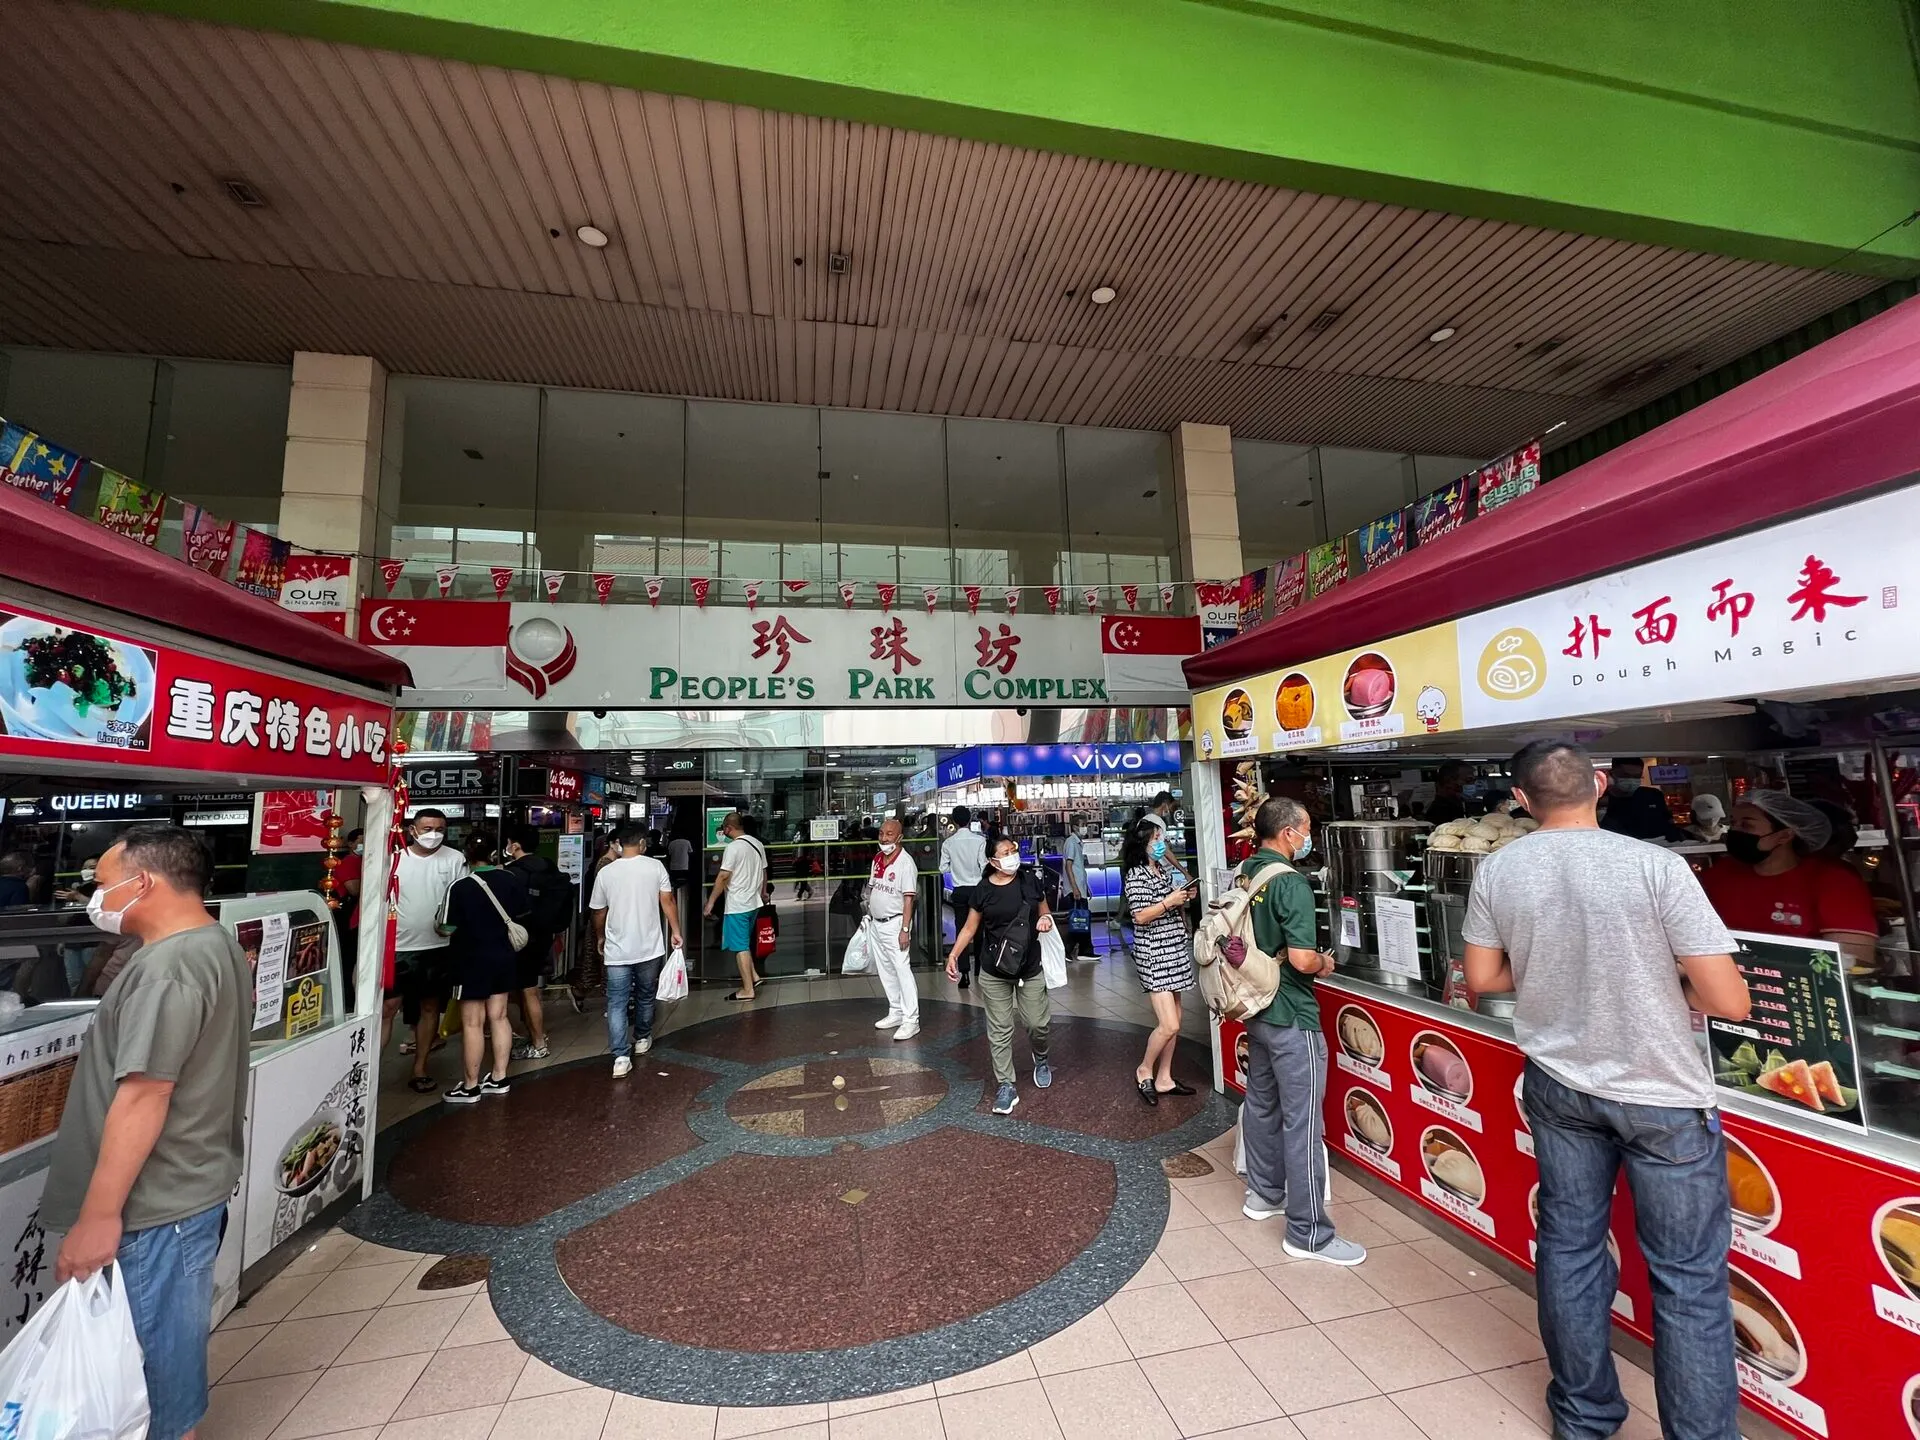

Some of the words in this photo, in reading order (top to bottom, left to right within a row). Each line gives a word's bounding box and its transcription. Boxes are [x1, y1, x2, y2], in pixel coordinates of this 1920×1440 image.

[53, 479, 72, 496] We
[100, 506, 141, 526] Together
[142, 513, 159, 526] We
[217, 530, 232, 544] We
[1314, 567, 1347, 596] Celebrate
[290, 589, 338, 601] OUR
[1207, 611, 1237, 620] OUR
[1561, 554, 1868, 660] 扑面而来
[751, 615, 1022, 675] 珍珠坊
[1572, 656, 1677, 687] Dough
[1714, 627, 1857, 664] Magic
[650, 667, 815, 700] PEOPLE'S
[848, 669, 936, 700] PARK
[964, 669, 1108, 700] COMPLEX
[166, 678, 387, 764] 重庆特色小吃
[97, 731, 126, 747] Liang
[127, 736, 145, 747] Fen
[676, 761, 691, 769] EXIT
[1072, 749, 1142, 770] vivo
[948, 762, 964, 780] vivo
[177, 793, 245, 801] TRAVELLERS
[1016, 783, 1069, 799] REPAIR
[51, 793, 120, 811] QUEEN
[184, 813, 212, 821] MONEY
[273, 944, 284, 953] OFF
[271, 971, 280, 980] OFF
[269, 998, 279, 1008] OFF
[291, 993, 320, 1016] EASI
[1751, 1248, 1777, 1265] BUN
[1737, 1362, 1763, 1385] 肉包
[1742, 1378, 1774, 1403] PORK
[1777, 1398, 1804, 1420] PAU
